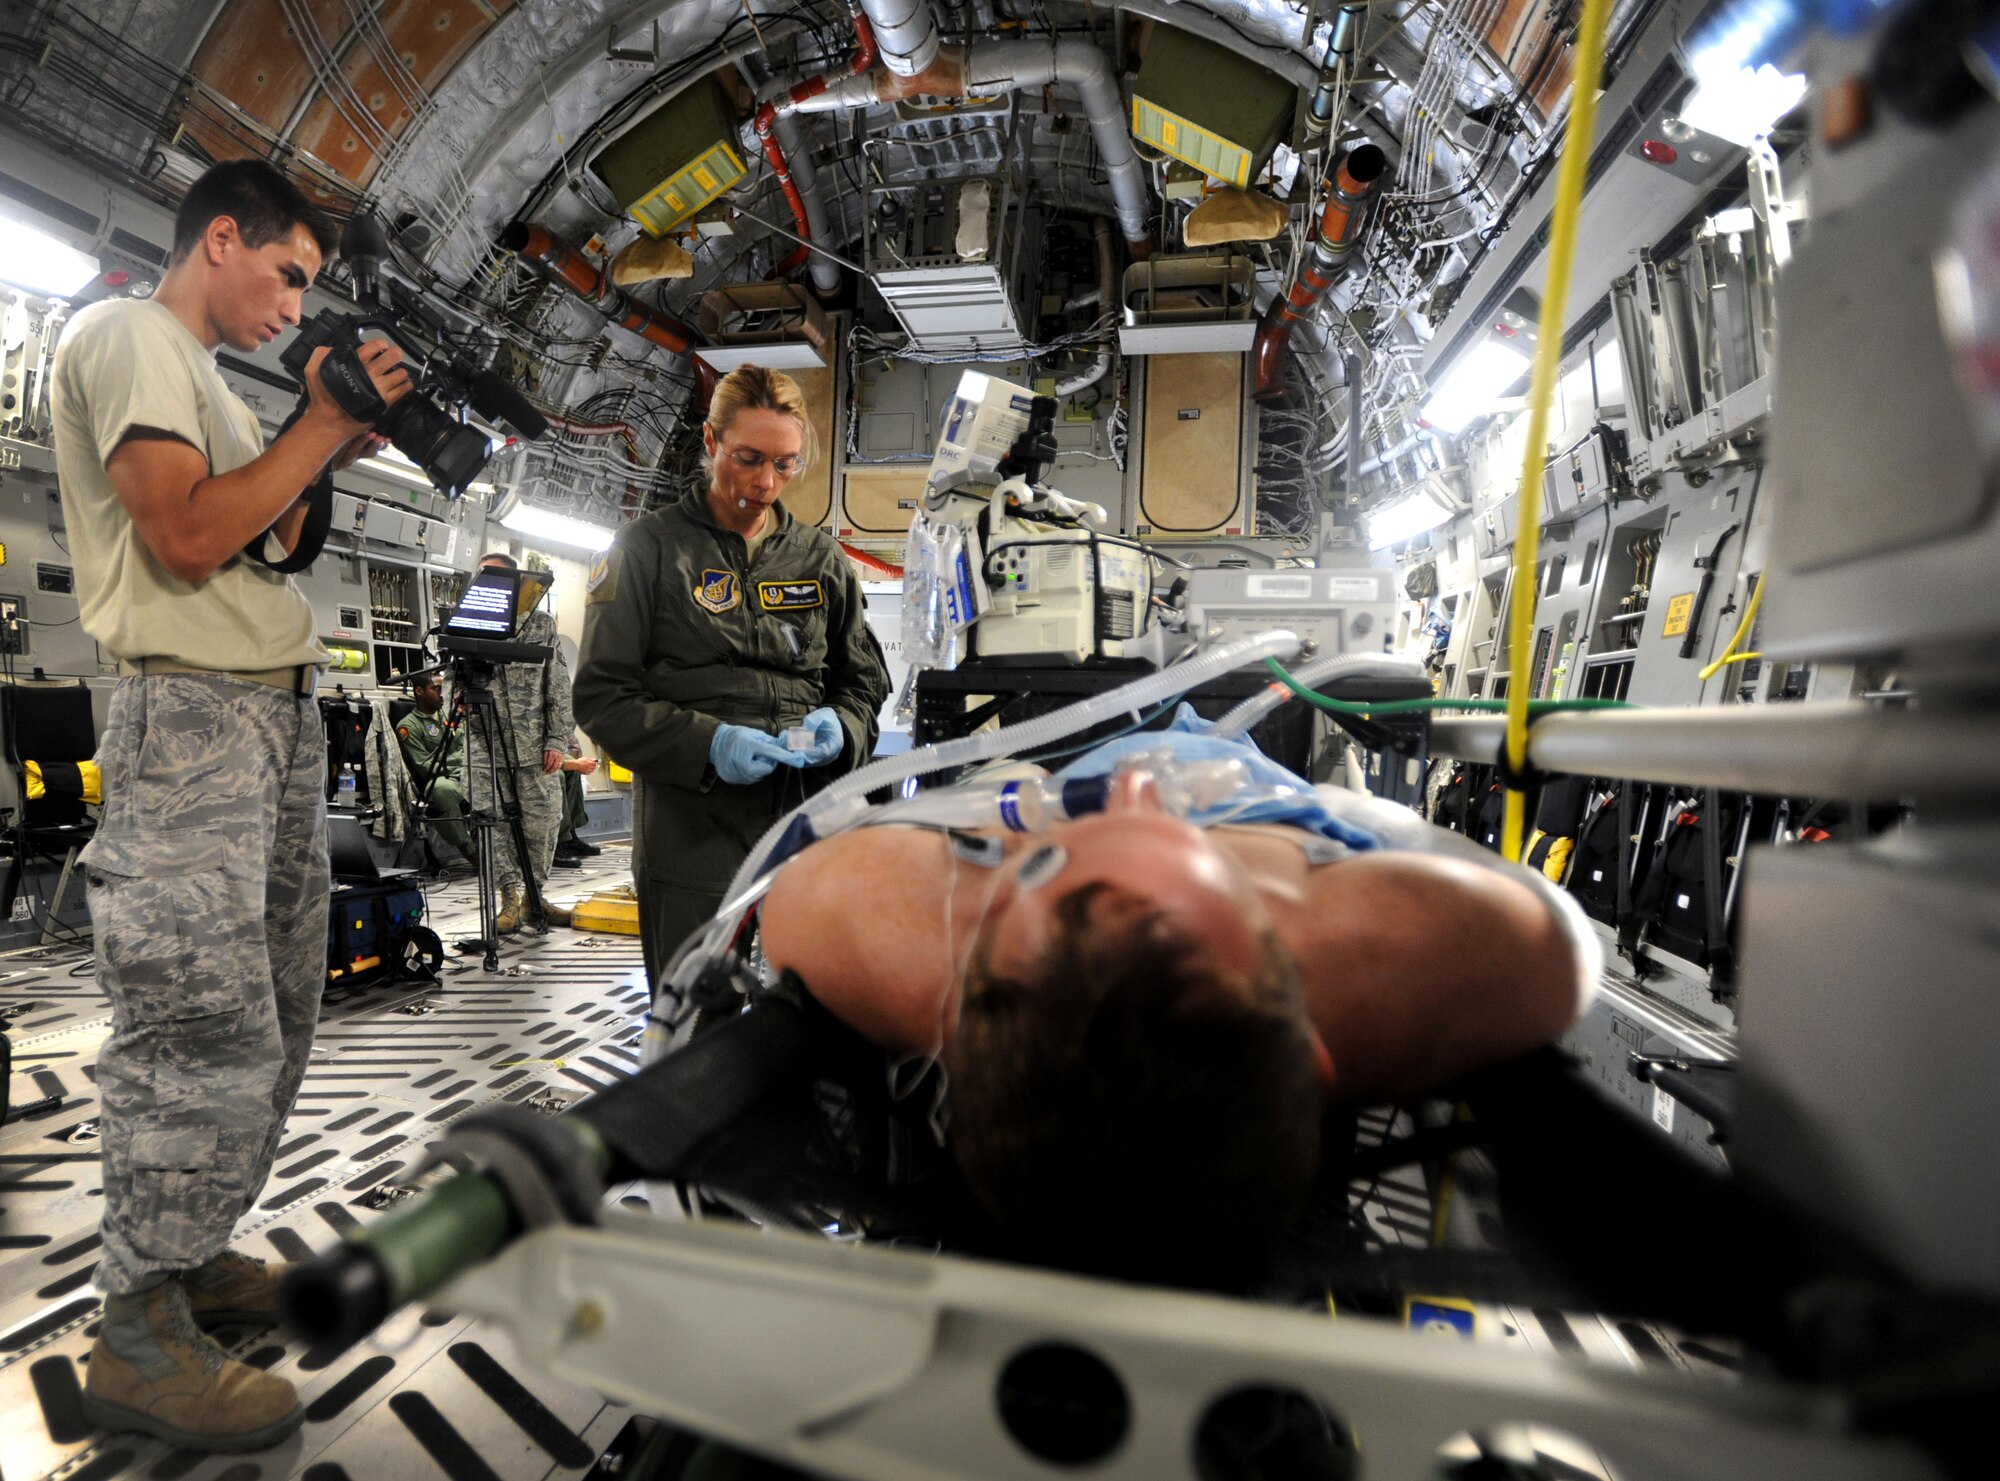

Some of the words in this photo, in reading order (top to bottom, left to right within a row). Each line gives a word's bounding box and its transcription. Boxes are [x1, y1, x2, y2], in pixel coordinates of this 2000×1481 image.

[618, 61, 648, 70] EXIT
[338, 363, 361, 393] SONY
[940, 446, 961, 460] DRC
[15, 911, 29, 919] 560
